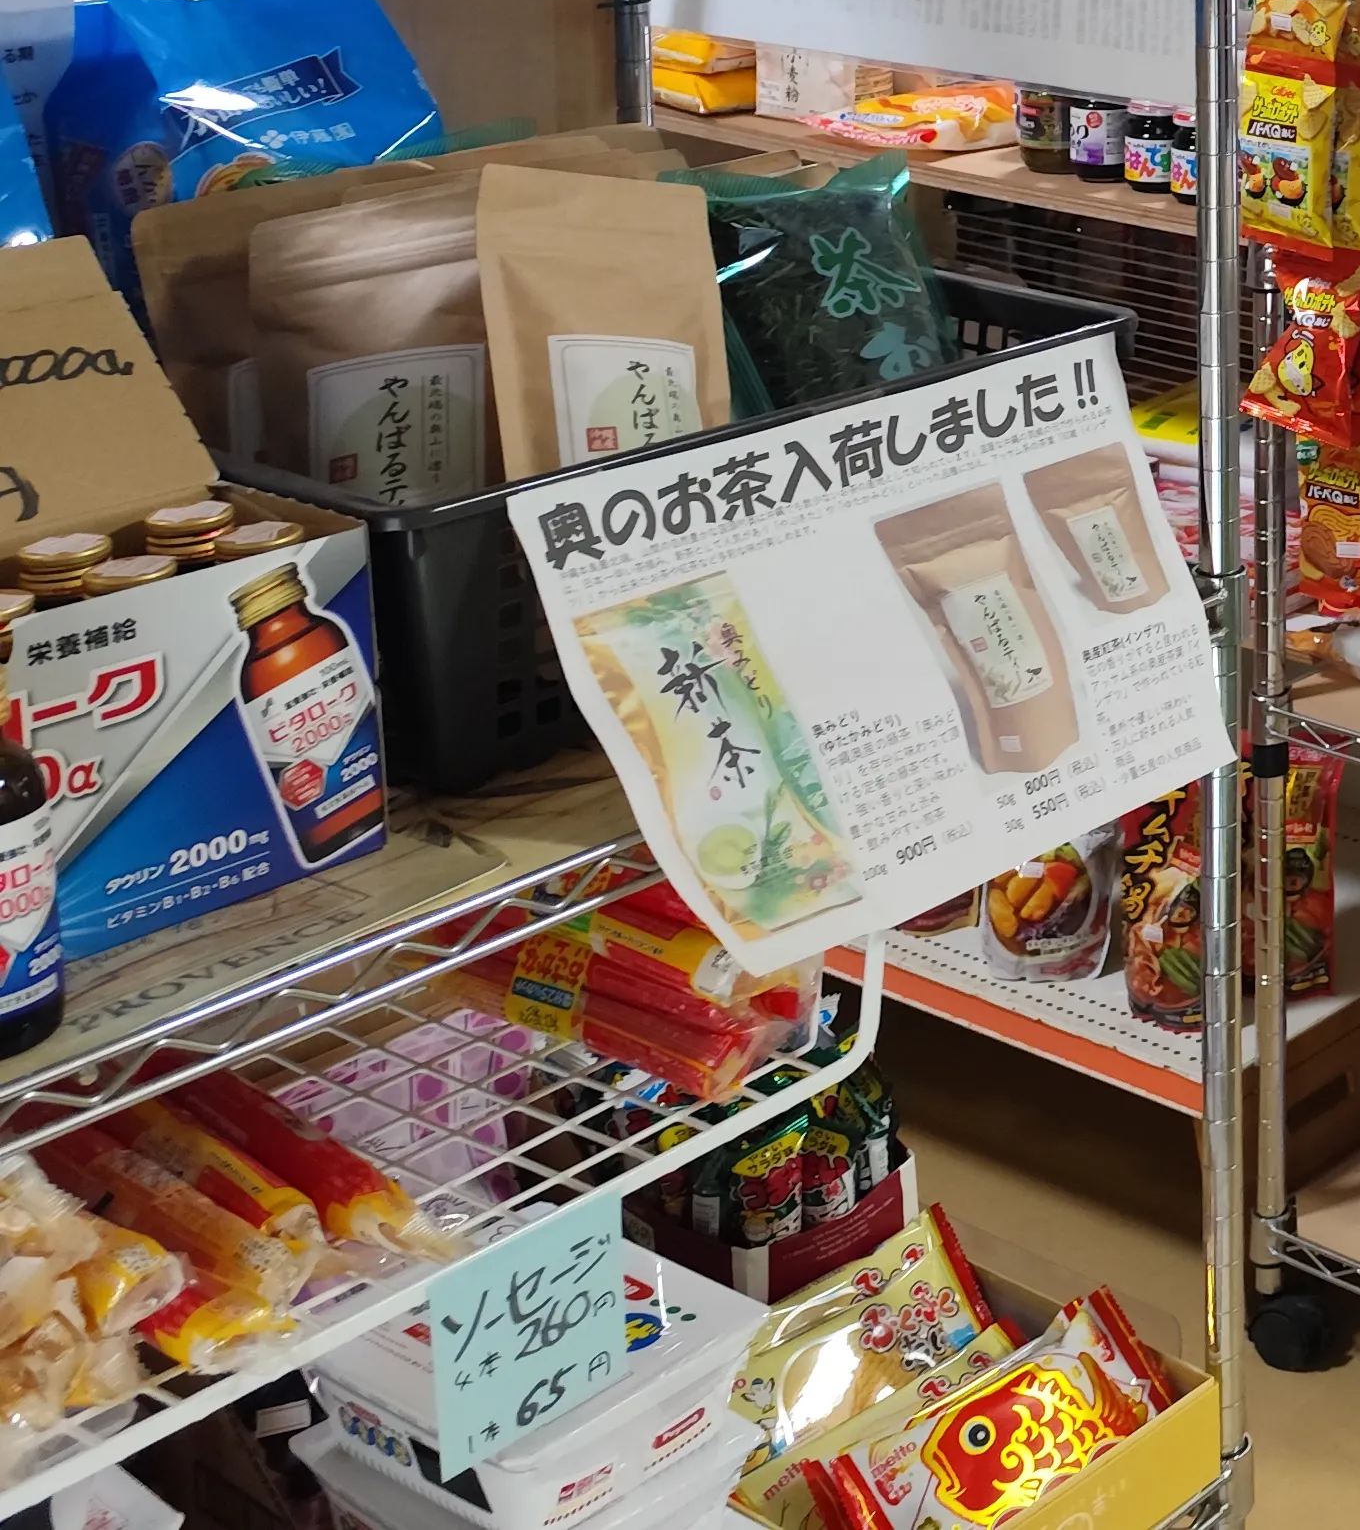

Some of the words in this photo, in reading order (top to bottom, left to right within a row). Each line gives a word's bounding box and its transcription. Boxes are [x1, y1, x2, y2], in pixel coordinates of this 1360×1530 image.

[289, 122, 356, 144] 伊藤園
[1248, 119, 1299, 144] バーベQあじ
[1251, 96, 1301, 123] サッポロポテト
[809, 225, 921, 320] 茶
[537, 358, 1100, 570] 奥のお茶入荷しました!!
[1306, 484, 1360, 506] バーベQあじ
[27, 617, 139, 667] 栄養補給
[720, 622, 773, 720] 奥みどり
[268, 681, 359, 745] ビタローク
[657, 641, 761, 790] 新茶
[996, 792, 1017, 809] 50g
[1024, 768, 1062, 796] 800円
[1031, 792, 1071, 820] 550円
[896, 834, 938, 865] 900円
[104, 861, 167, 896] タウリン
[441, 1235, 614, 1364] ソーセージ
[515, 1289, 619, 1365] 260円
[516, 1348, 613, 1427] 65円
[762, 1456, 810, 1503] meito
[868, 1439, 919, 1479] meito
